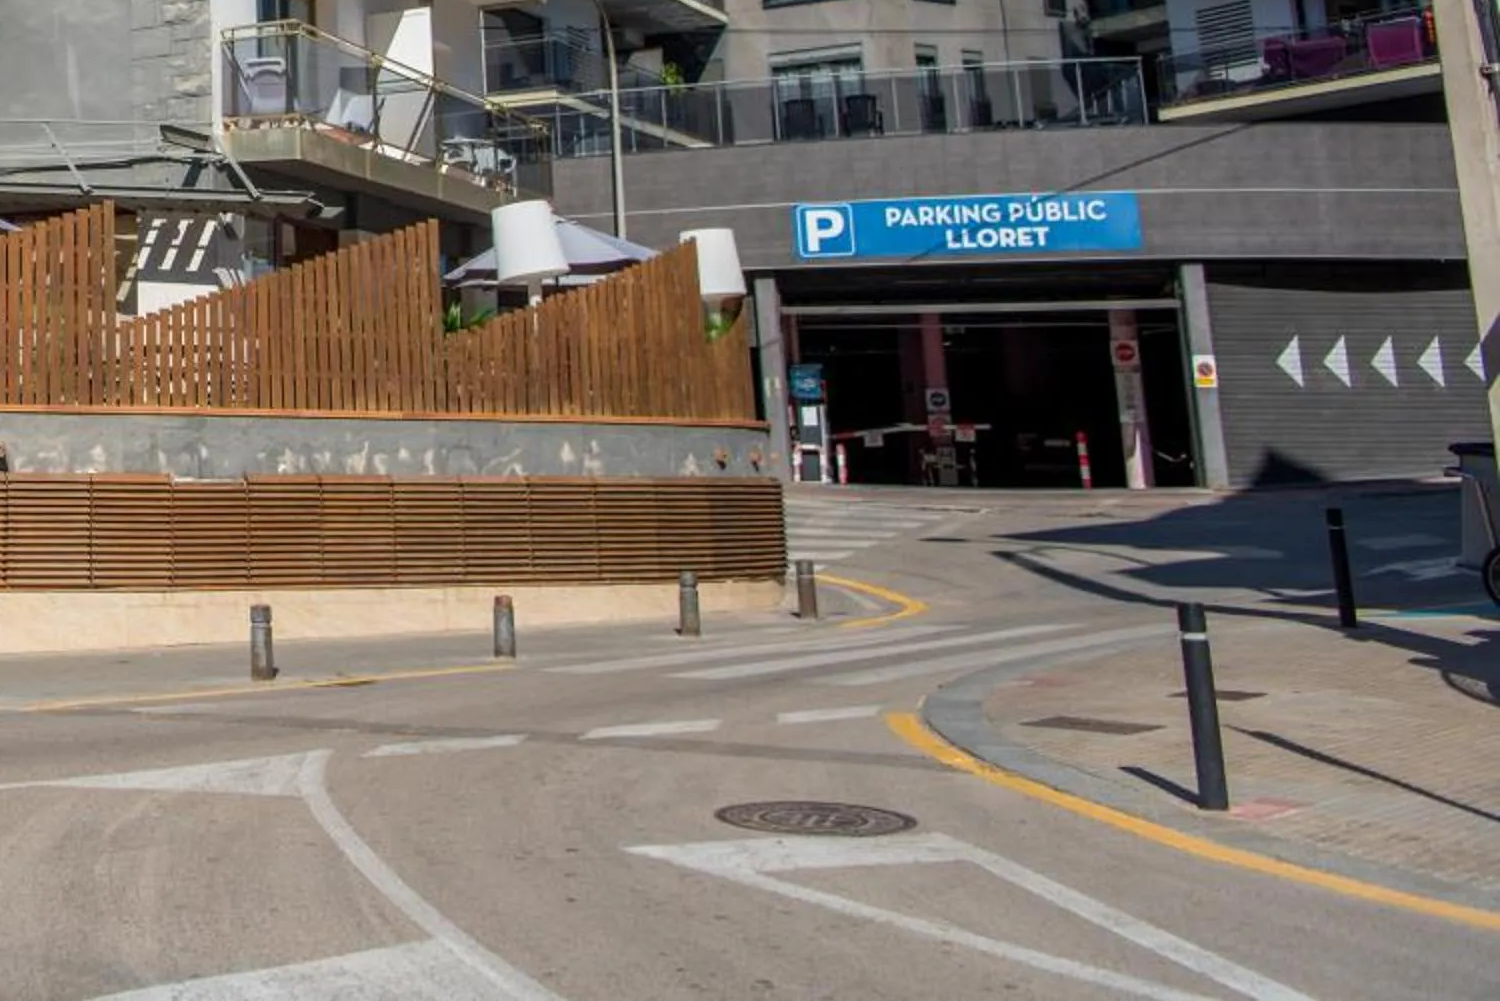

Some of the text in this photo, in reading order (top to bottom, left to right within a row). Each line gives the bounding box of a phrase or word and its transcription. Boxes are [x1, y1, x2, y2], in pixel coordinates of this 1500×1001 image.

[885, 195, 1107, 228] PARKING PÚBLIC
[804, 209, 845, 252] P
[945, 226, 1049, 249] LLORET
